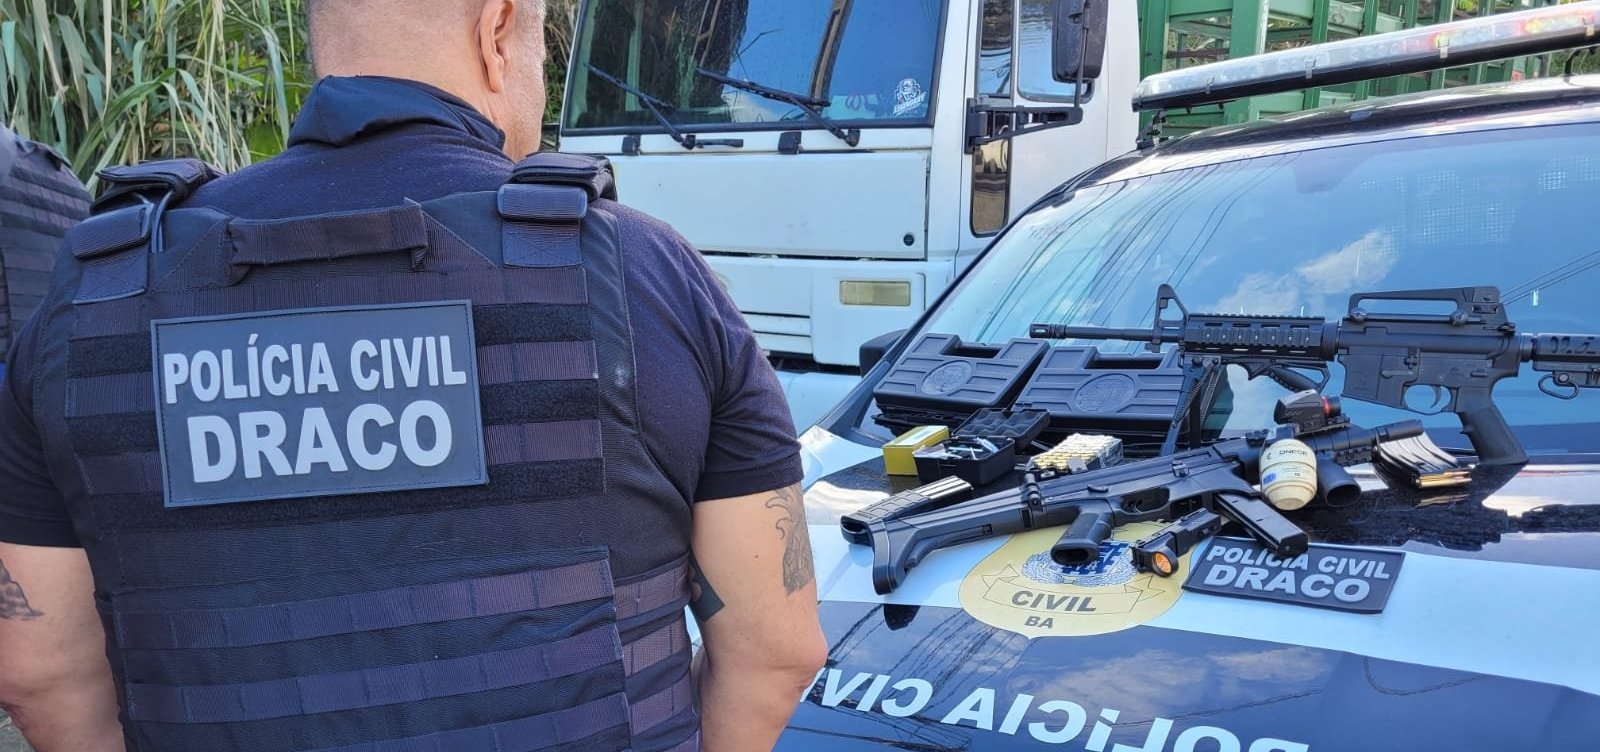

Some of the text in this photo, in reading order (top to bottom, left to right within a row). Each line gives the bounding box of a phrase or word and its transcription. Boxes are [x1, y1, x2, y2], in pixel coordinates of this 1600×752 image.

[163, 333, 467, 404] POLÍCIA CIVIL
[187, 400, 452, 483] DRACO
[1318, 556, 1390, 579] CIVIL
[1203, 564, 1370, 602] DRACO
[1011, 590, 1097, 612] CIVIL
[1024, 615, 1054, 629] BA
